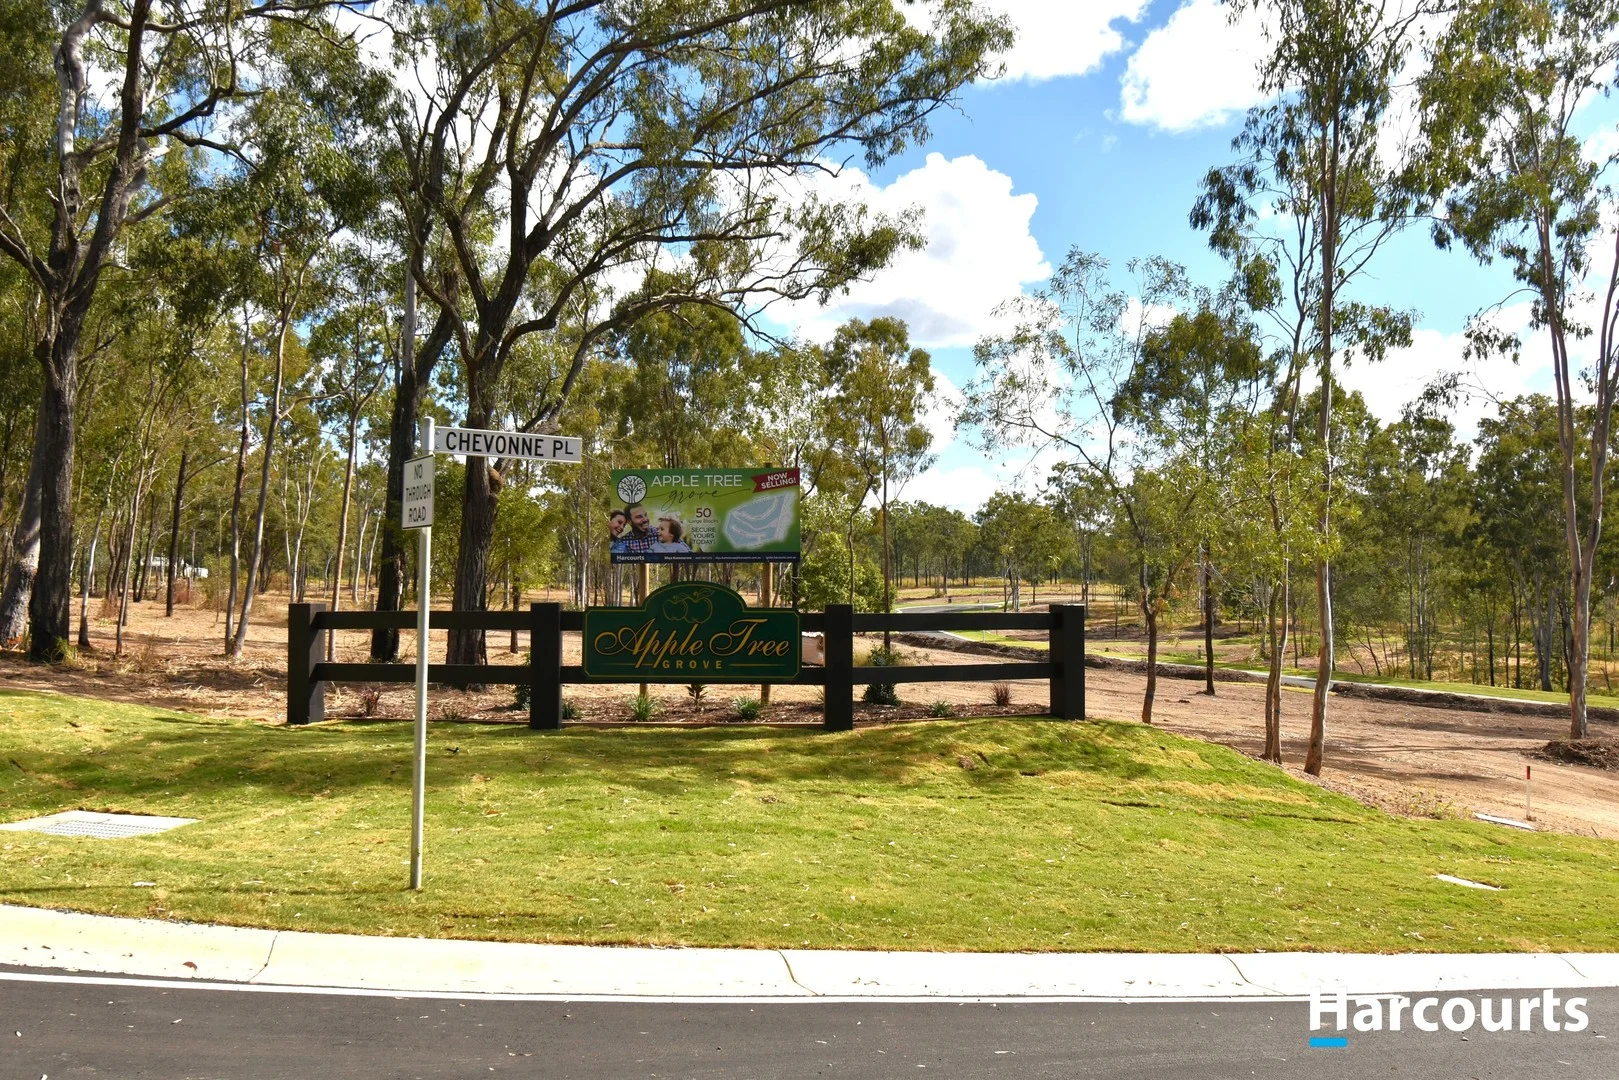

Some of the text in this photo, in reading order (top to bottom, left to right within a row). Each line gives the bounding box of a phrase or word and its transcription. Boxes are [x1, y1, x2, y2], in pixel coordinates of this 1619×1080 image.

[445, 431, 574, 458] CHEVONNE PL
[413, 463, 423, 481] NO
[767, 472, 788, 482] NOW
[651, 474, 743, 488] APPLE TREE
[761, 476, 797, 490] SELLING!
[405, 483, 432, 503] THROUGH
[661, 489, 735, 512] grove
[408, 506, 427, 523] ROAD
[695, 507, 712, 518] 50
[594, 617, 790, 669] Apple Tree
[662, 660, 722, 669] GROVE
